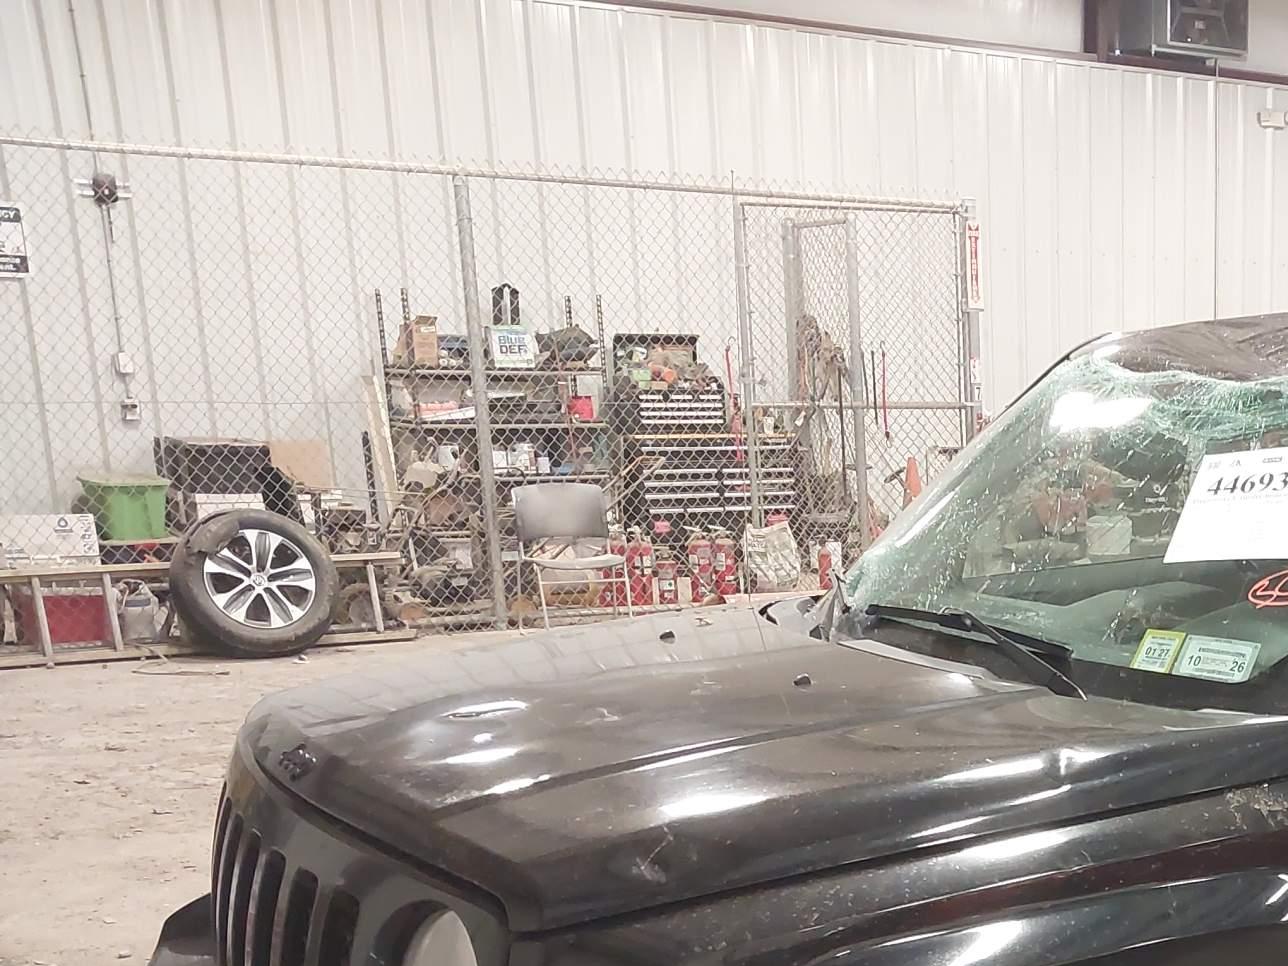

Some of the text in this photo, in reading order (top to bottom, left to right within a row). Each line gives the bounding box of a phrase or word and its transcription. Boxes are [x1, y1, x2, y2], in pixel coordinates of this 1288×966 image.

[499, 345, 528, 355] DEF
[1145, 646, 1170, 658] 01 27
[1187, 655, 1246, 673] 10 26
